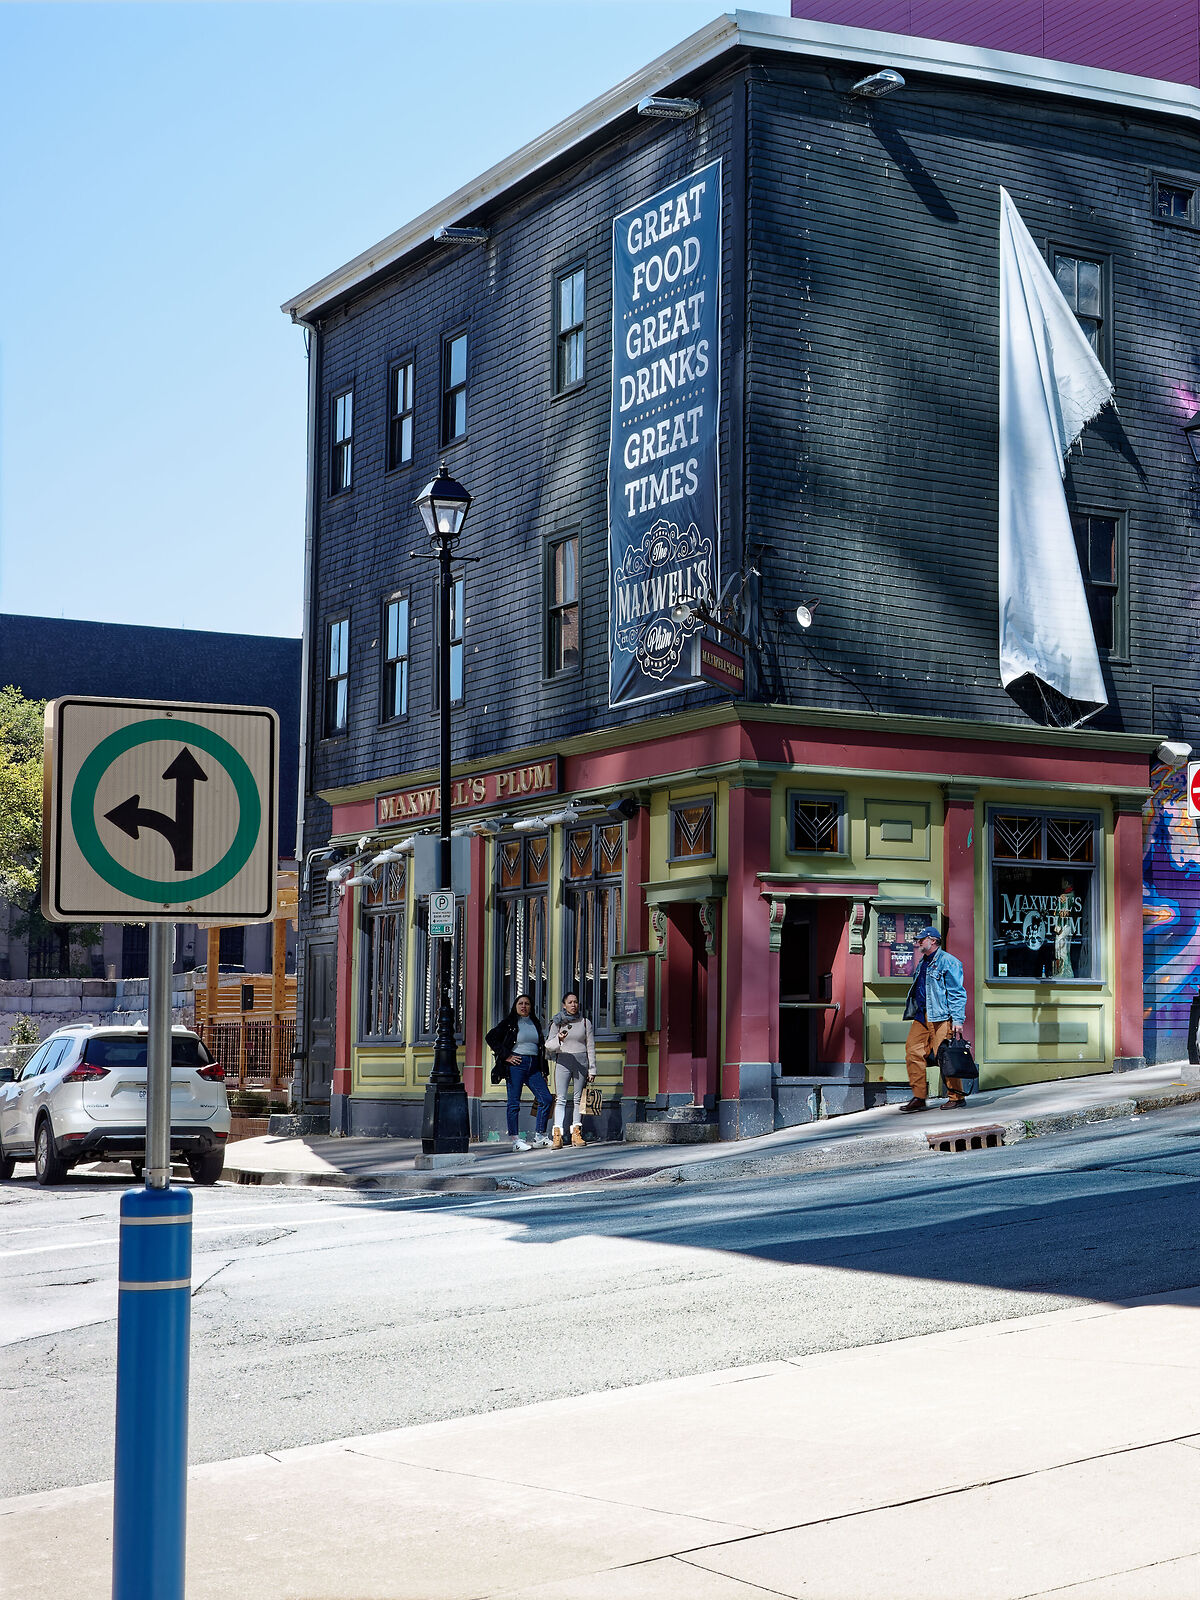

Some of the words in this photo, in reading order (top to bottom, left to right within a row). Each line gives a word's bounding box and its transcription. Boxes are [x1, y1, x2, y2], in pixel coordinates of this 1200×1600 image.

[627, 181, 706, 255] GREAT
[632, 236, 701, 302] FOOD
[626, 291, 705, 360] GREAT
[620, 340, 708, 413] DRINKS
[624, 405, 704, 470] GREAT
[624, 458, 698, 518] TIMES
[653, 542, 667, 561] The
[619, 559, 708, 626] MAXWELL'S
[647, 625, 672, 653] Plum
[495, 763, 553, 797] PLUM
[1001, 894, 1082, 924] MAXWELL'S
[1046, 915, 1082, 936] PLUM
